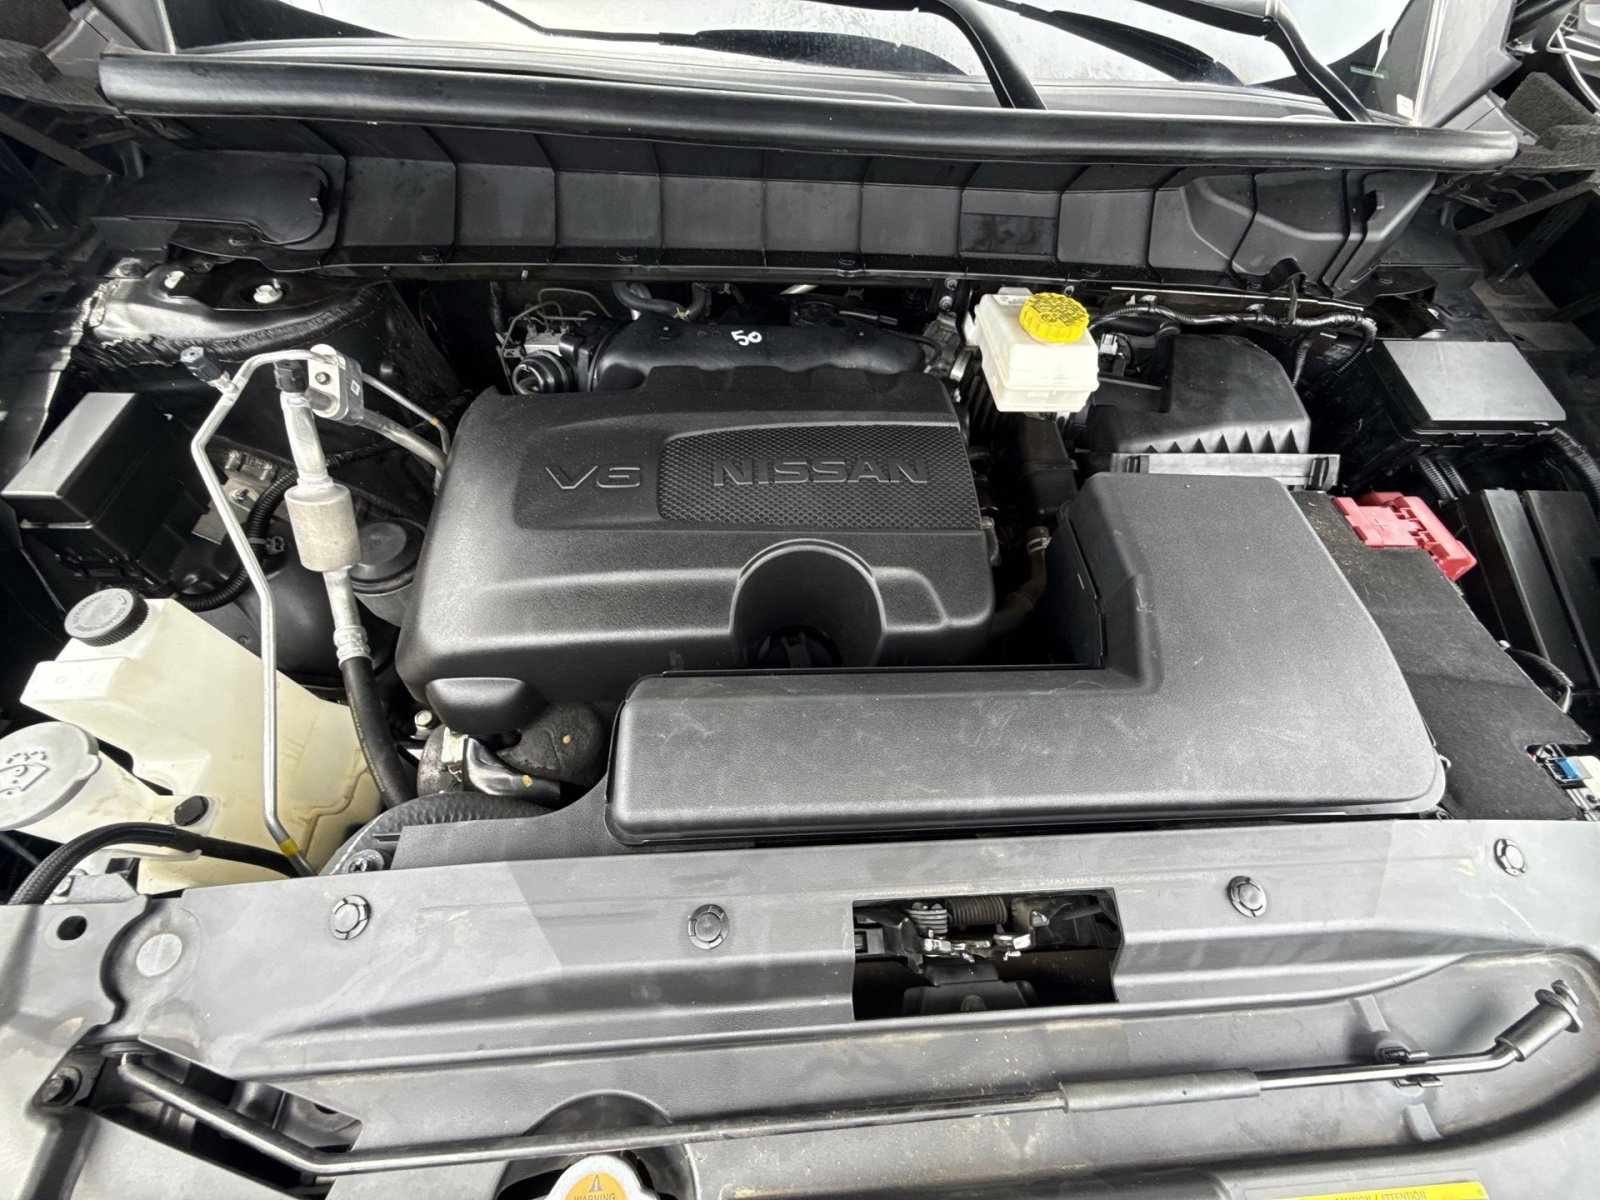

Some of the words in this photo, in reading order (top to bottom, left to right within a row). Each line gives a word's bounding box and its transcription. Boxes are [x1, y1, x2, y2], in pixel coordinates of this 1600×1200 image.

[731, 329, 762, 346] 50
[545, 464, 641, 490] V6
[713, 456, 929, 487] NISSAN
